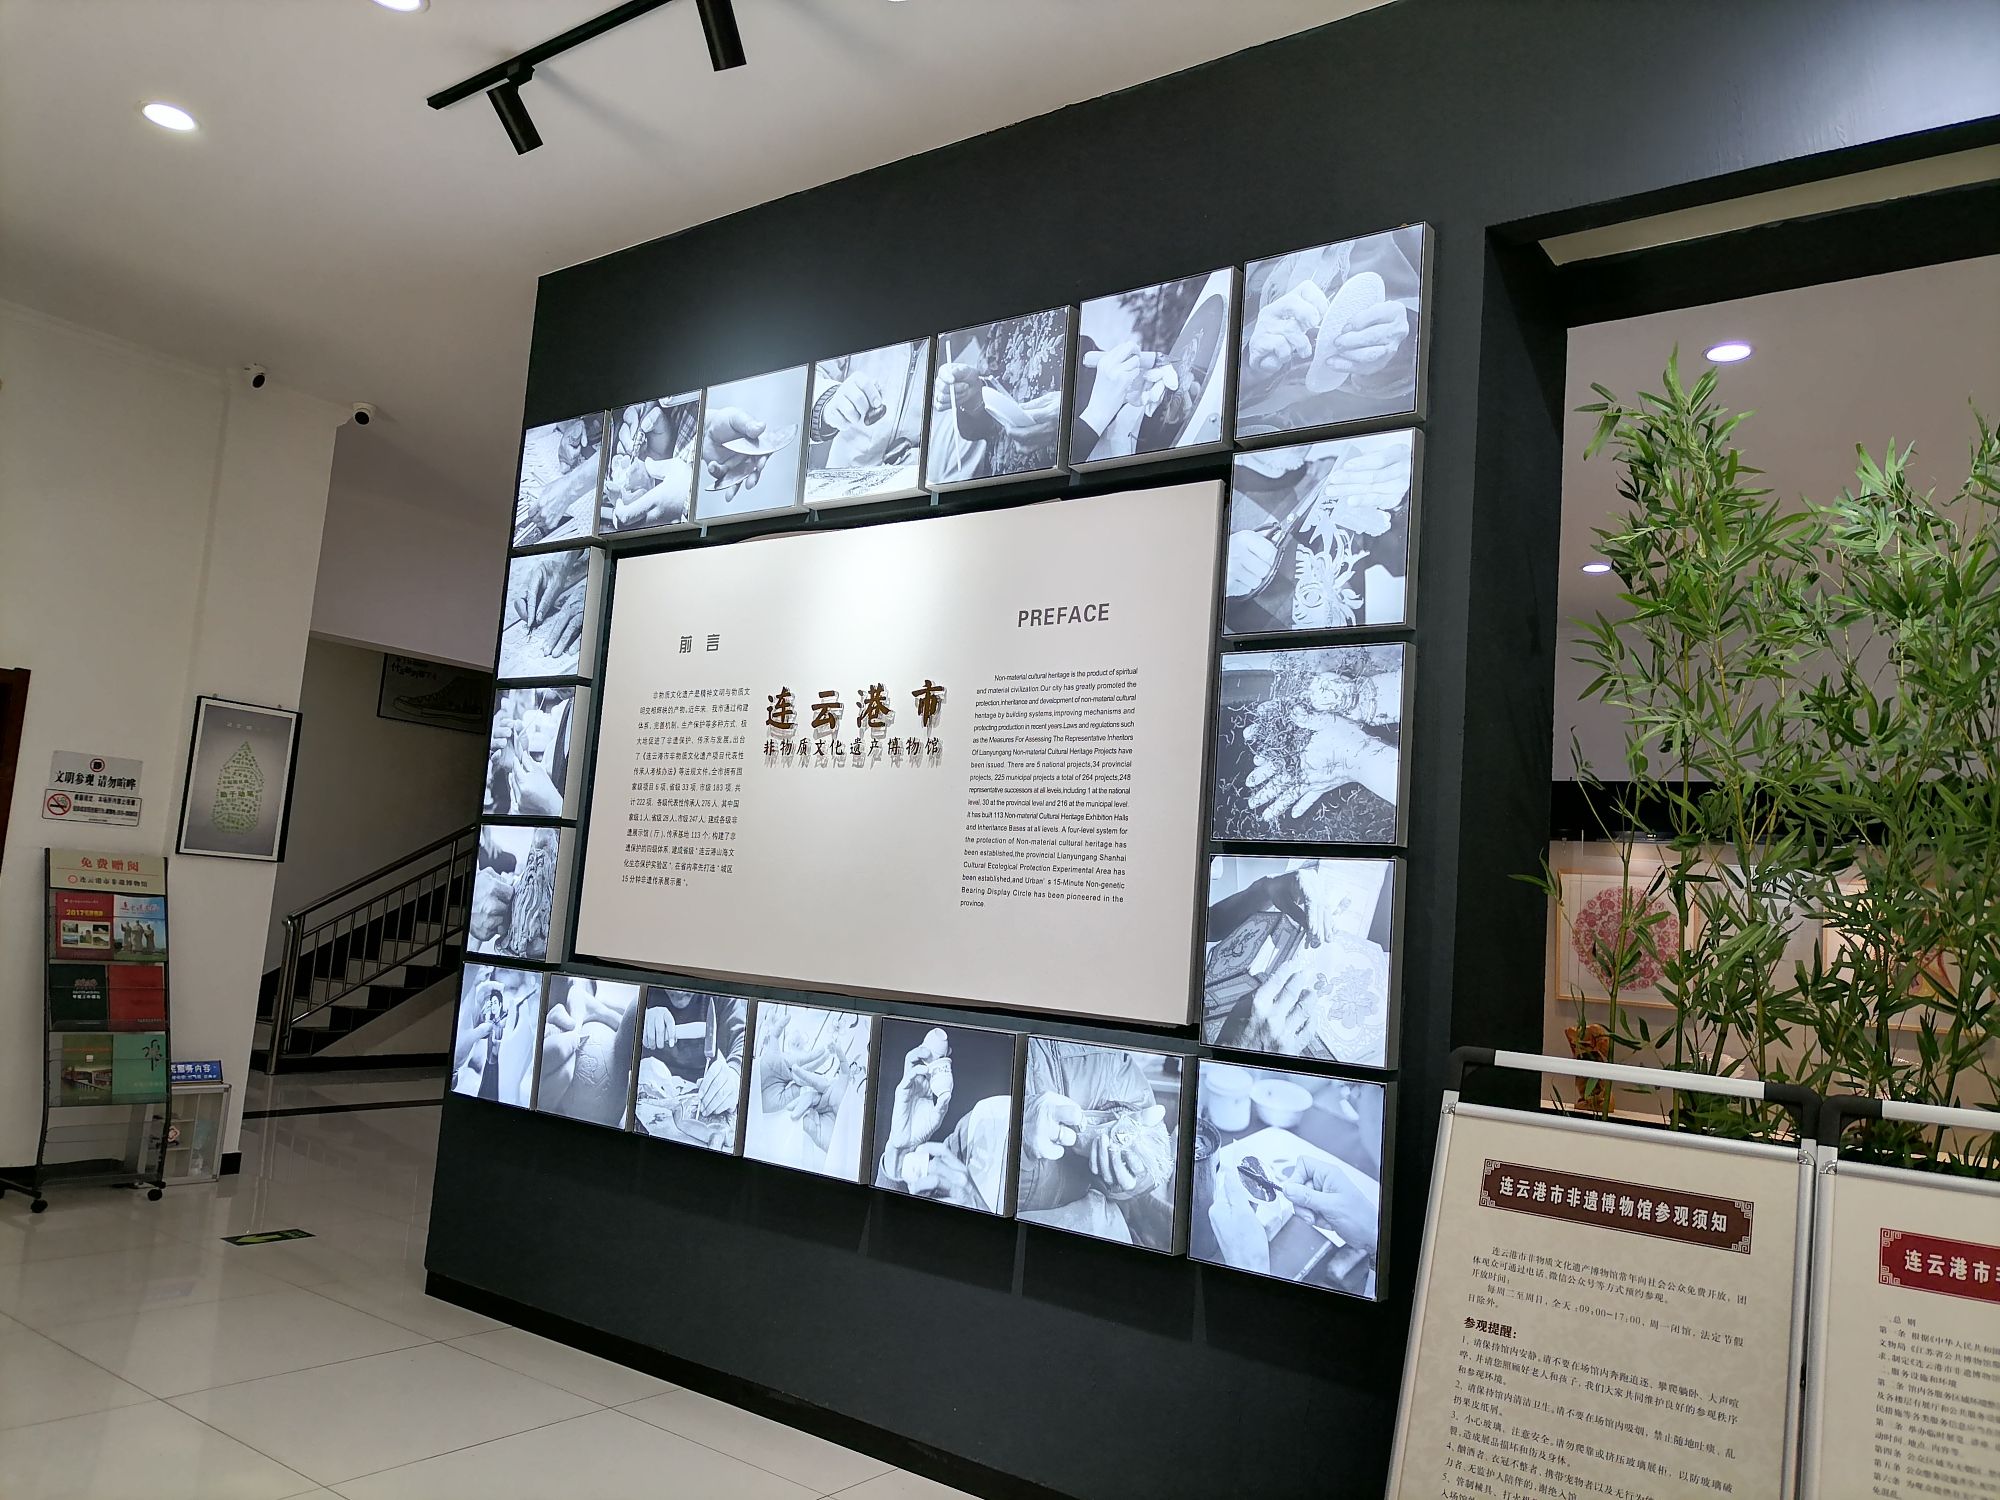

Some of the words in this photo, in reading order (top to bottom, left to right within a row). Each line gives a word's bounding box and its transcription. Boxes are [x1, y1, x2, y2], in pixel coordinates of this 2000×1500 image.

[1018, 602, 1110, 627] PREFACE
[994, 673, 1027, 681] Non-material
[1047, 671, 1069, 680] heritage
[1086, 669, 1108, 678] product
[1115, 667, 1138, 677] spiritual
[1075, 682, 1095, 691] greatly
[1096, 681, 1125, 690] promoted
[766, 680, 945, 729] 连云港市
[1039, 696, 1073, 706] development
[1080, 695, 1115, 703] non-material
[974, 711, 996, 720] heritage
[1005, 710, 1027, 719] building
[1083, 707, 1121, 715] mechanisms
[973, 723, 997, 732] protecting
[997, 723, 1024, 731] production
[1089, 721, 1119, 730] regulations
[988, 735, 1014, 743] Measures
[1024, 735, 1051, 744] Assessing
[1064, 734, 1106, 743] Representative
[1106, 733, 1133, 741] Inheritors
[764, 738, 940, 756] 非物质文化遗产博物馆
[978, 748, 1011, 757] Lianyungang
[1069, 747, 1092, 756] Heritage
[1093, 747, 1117, 756] Projects
[1066, 760, 1100, 769] projects,34
[1101, 760, 1131, 769] provincial
[55, 770, 94, 786] 文明参观
[98, 775, 136, 790] 请勿喧哗
[1005, 774, 1031, 782] municipal
[1032, 774, 1055, 782] projects
[1094, 774, 1131, 782] projects,248
[968, 786, 1003, 794] representative
[1005, 799, 1030, 807] provincial
[1085, 800, 1112, 808] municipal
[1060, 813, 1084, 821] Heritage
[1008, 824, 1025, 832] Bases
[1095, 826, 1118, 835] system
[975, 836, 1006, 845] protection
[1015, 837, 1057, 845] Non-material
[1084, 839, 1112, 849] heritage
[1025, 851, 1055, 860] provincial
[1056, 852, 1097, 861] Lianyungang
[1099, 853, 1126, 861] Shanhai
[82, 857, 138, 872] 免费赠阅
[963, 861, 986, 869] Cultural
[987, 862, 1017, 872] Ecological
[1019, 863, 1050, 871] Protection
[1052, 865, 1093, 875] Experimental
[1053, 878, 1084, 886] 15-Minute
[1085, 880, 1125, 890] Non-genetic
[961, 887, 985, 896] Bearing
[986, 888, 1010, 897] Display
[1012, 889, 1032, 897] Circle
[1066, 892, 1101, 902] pioneered
[1499, 1176, 1728, 1233] 连云港市非遗博物馆参观须知
